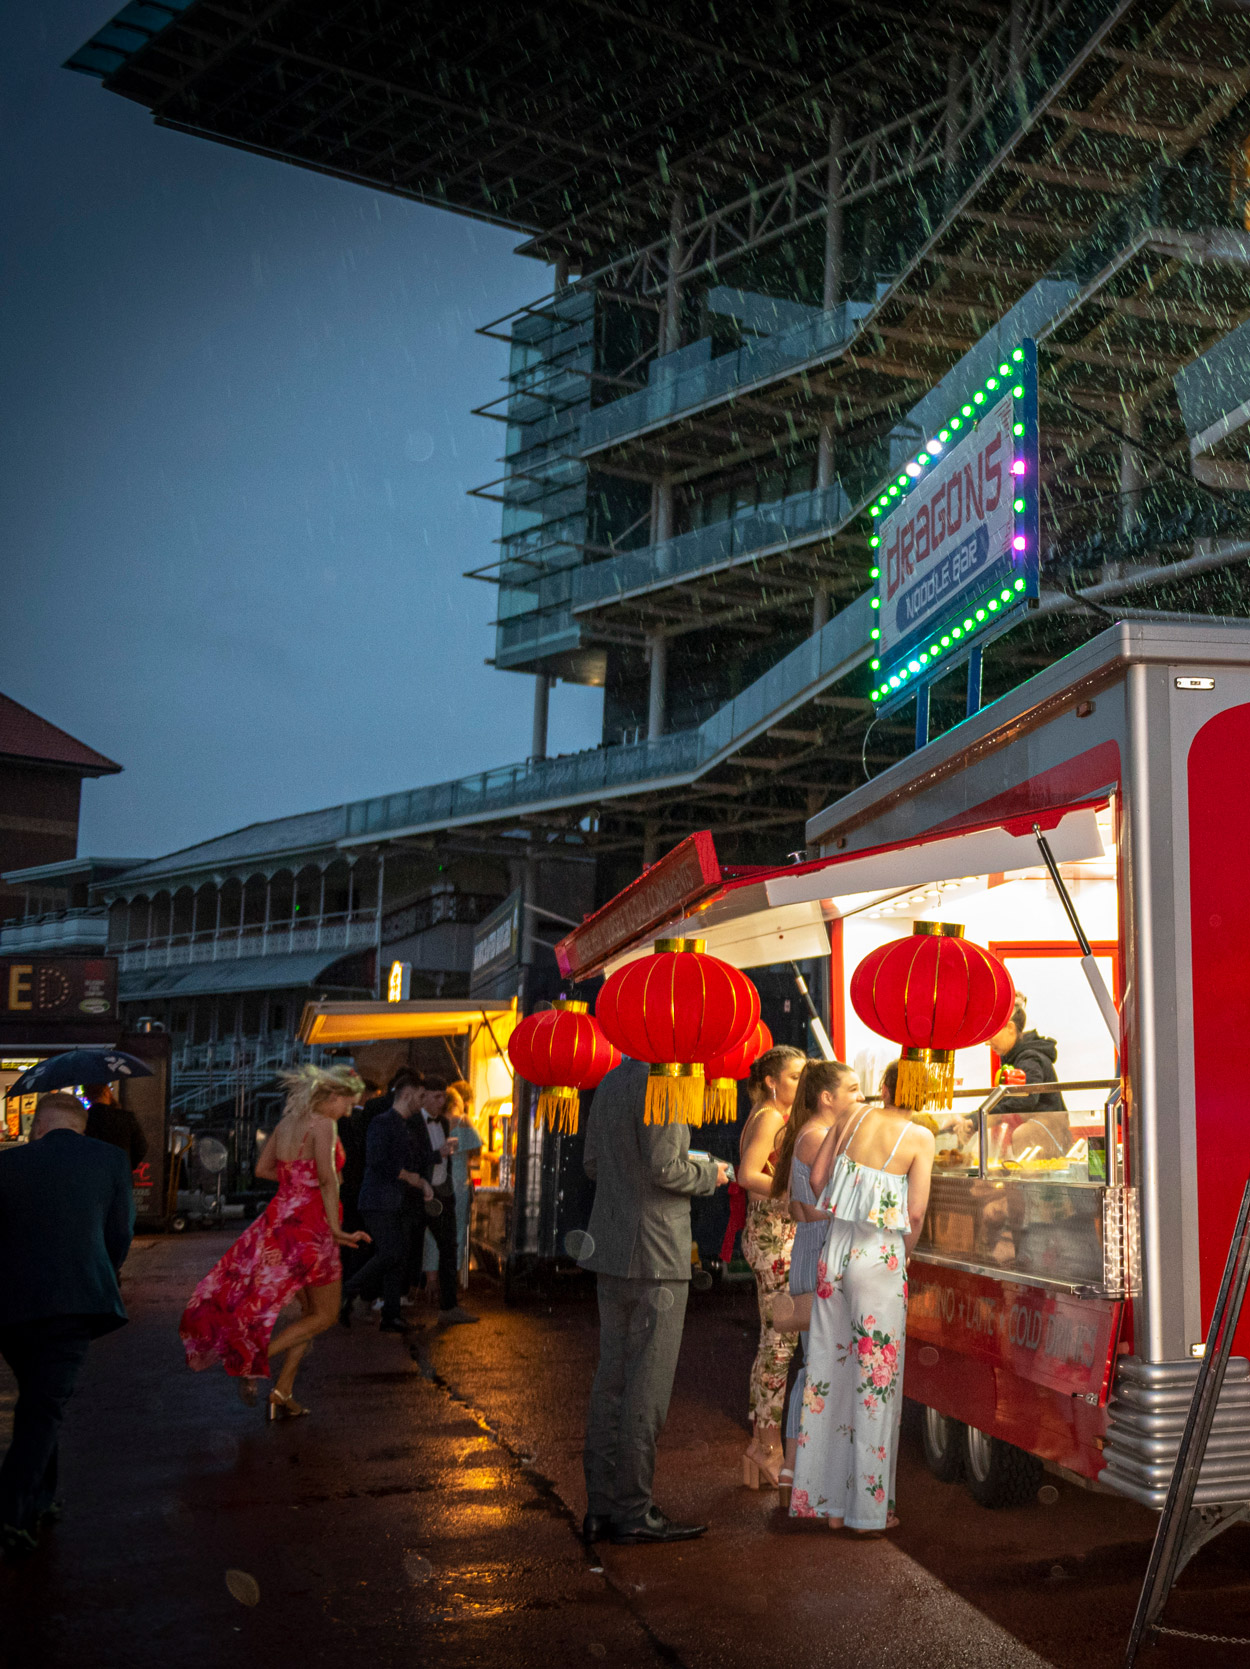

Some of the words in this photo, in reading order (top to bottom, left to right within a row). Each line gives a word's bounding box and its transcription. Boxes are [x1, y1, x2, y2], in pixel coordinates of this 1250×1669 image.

[905, 560, 950, 620] NOODLE
[1008, 1303, 1043, 1350] COLD
[1044, 1313, 1098, 1369] DRINKS
